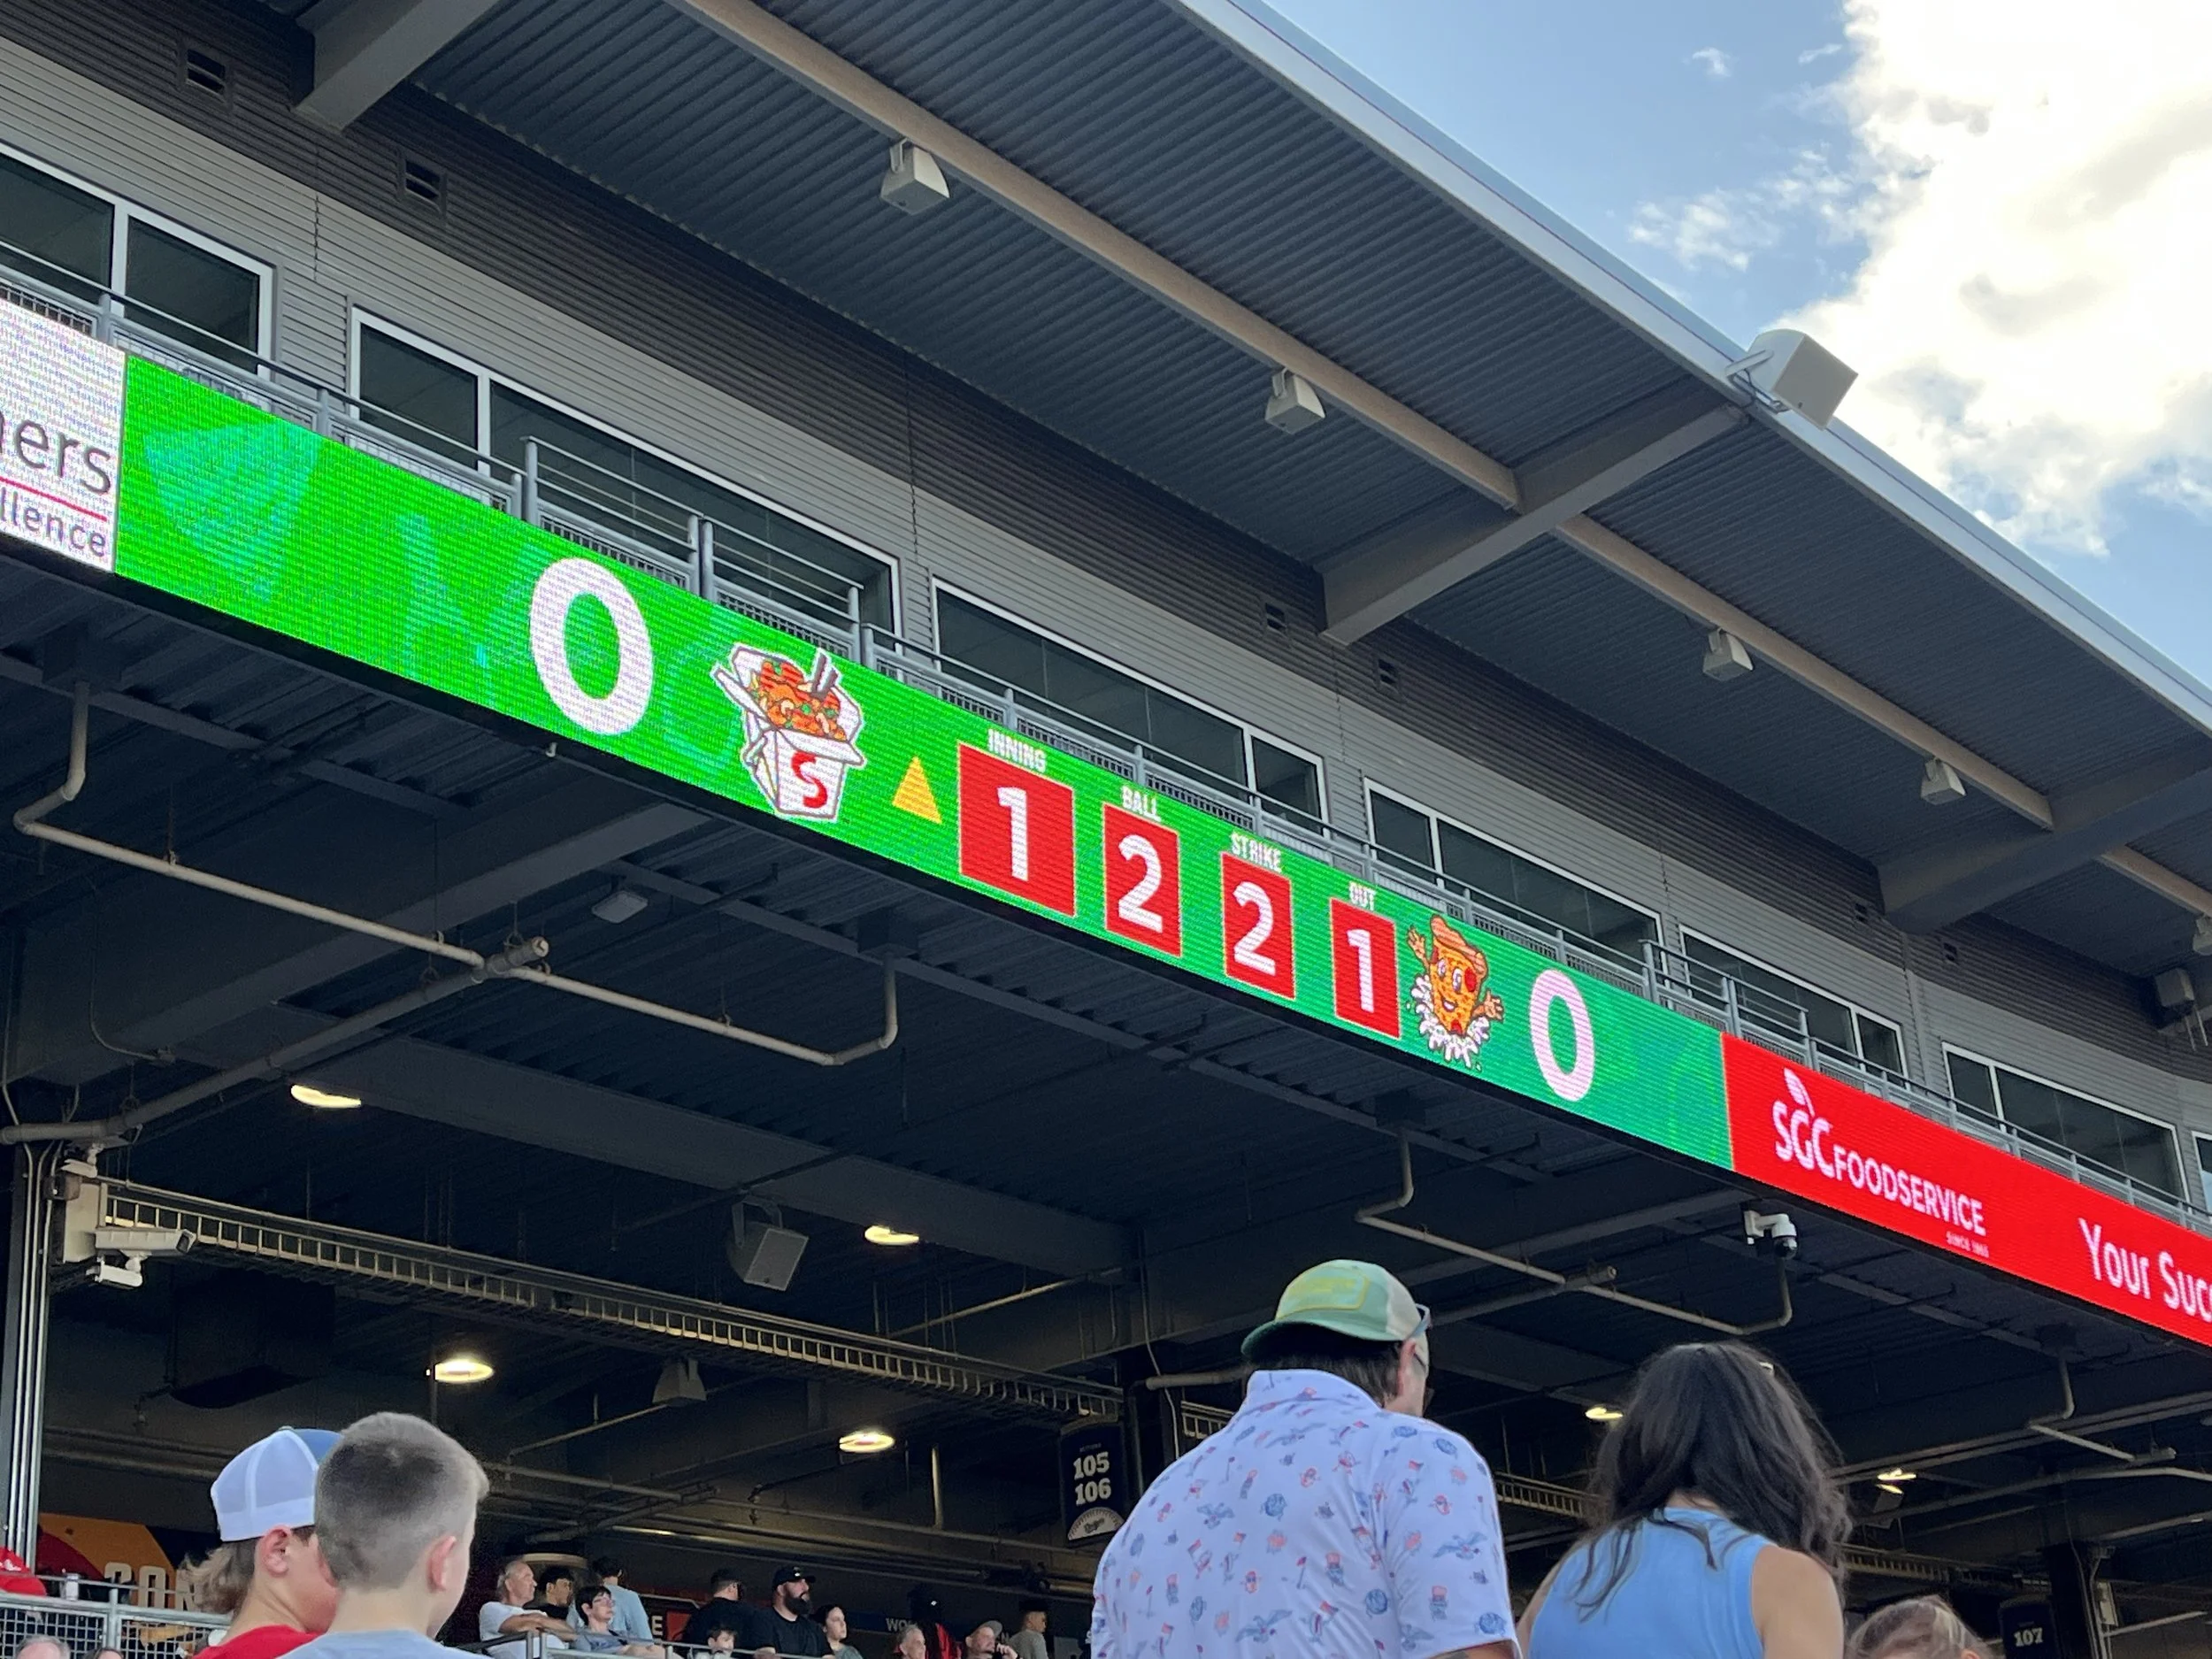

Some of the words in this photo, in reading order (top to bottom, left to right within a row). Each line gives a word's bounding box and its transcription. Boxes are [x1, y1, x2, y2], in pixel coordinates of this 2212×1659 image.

[0, 411, 111, 495] ers
[0, 488, 105, 557] llence
[530, 557, 654, 735] 0
[790, 752, 828, 809] S
[987, 728, 1047, 773] INNING
[997, 787, 1029, 882] 1
[1121, 785, 1161, 823] BALL
[1118, 834, 1164, 933] 2
[1231, 830, 1283, 873] STRIKE
[1232, 881, 1277, 976] 2
[1348, 881, 1377, 911] OUT
[1347, 928, 1375, 1013] 1
[1528, 969, 1595, 1102] 0
[2078, 1217, 2151, 1300] Your
[2159, 1250, 2212, 1323] Suc
[1073, 1451, 1110, 1480] 105
[1075, 1478, 1112, 1506] 106
[2013, 1626, 2044, 1647] 107
